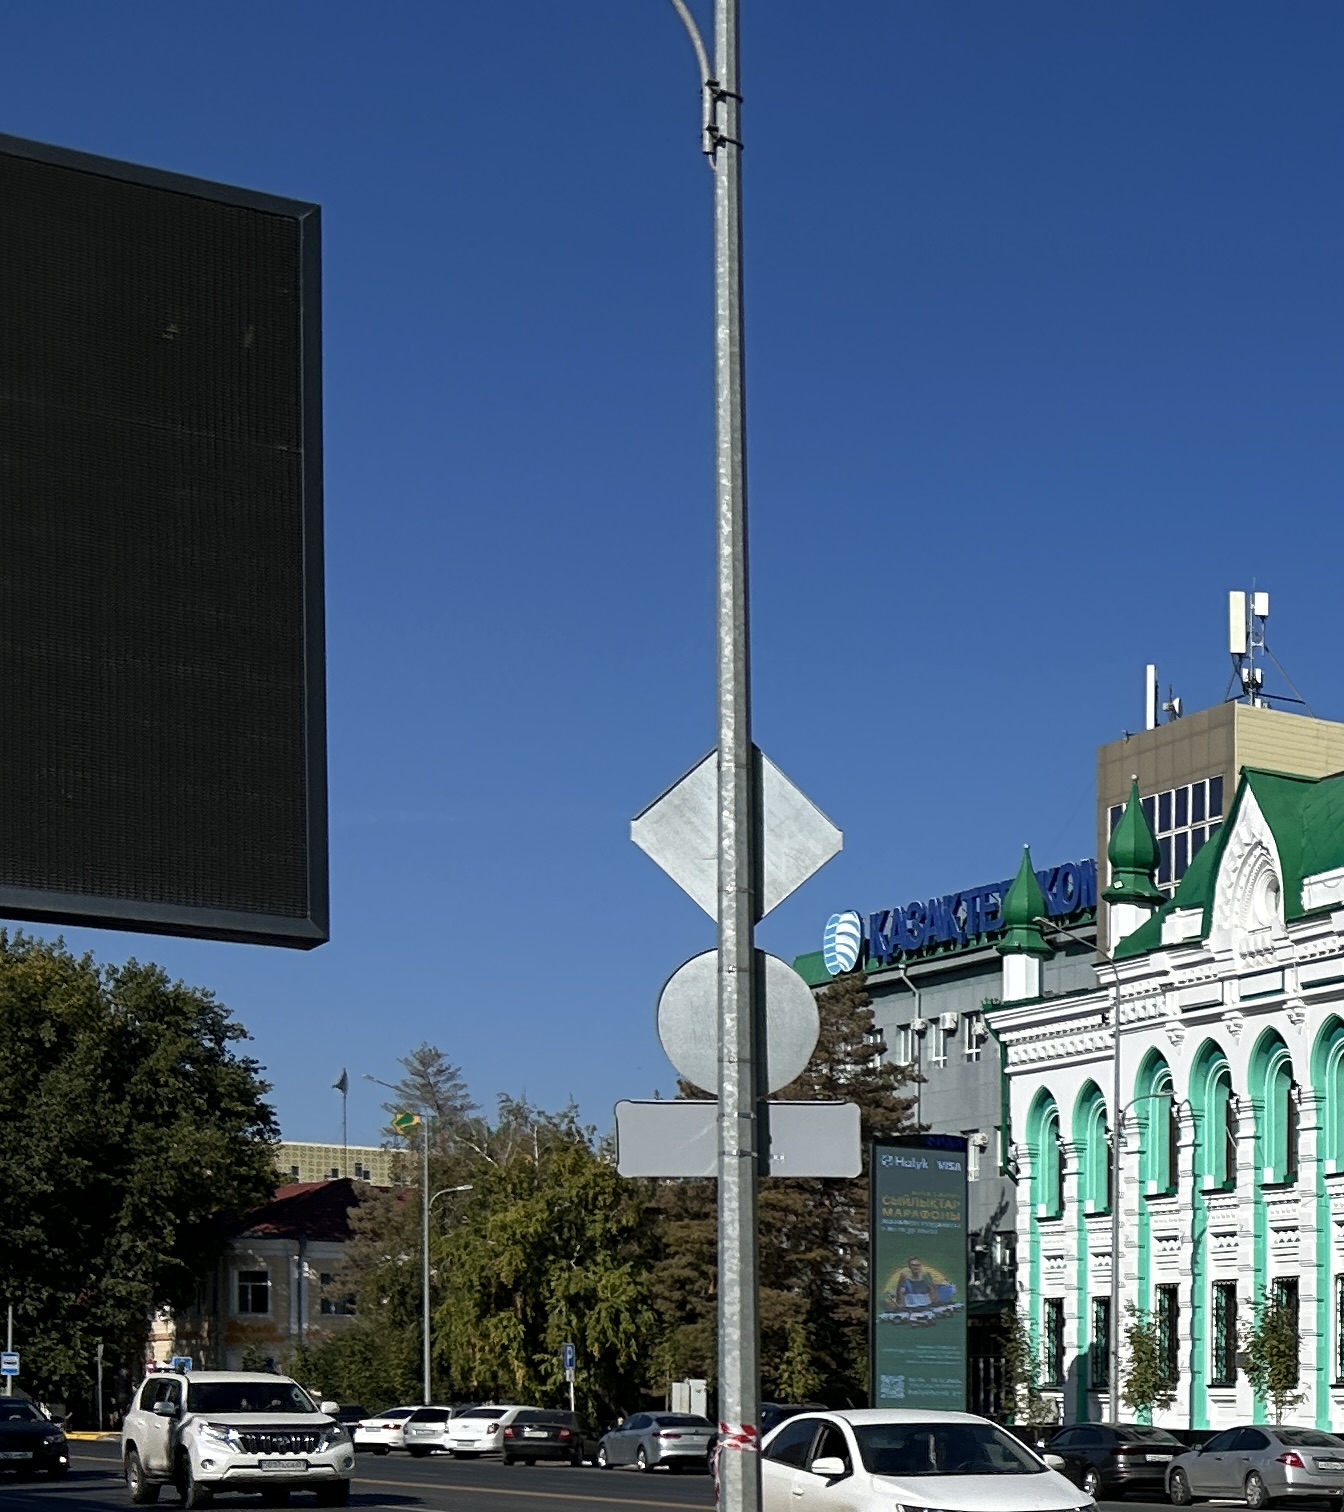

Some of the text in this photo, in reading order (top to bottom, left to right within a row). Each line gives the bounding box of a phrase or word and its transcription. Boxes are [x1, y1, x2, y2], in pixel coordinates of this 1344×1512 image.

[869, 858, 1097, 962] ҚАЗАҚТЕКОМ
[895, 1156, 962, 1172] Halyk VISA
[881, 1208, 961, 1221] МАРАФОНЫ
